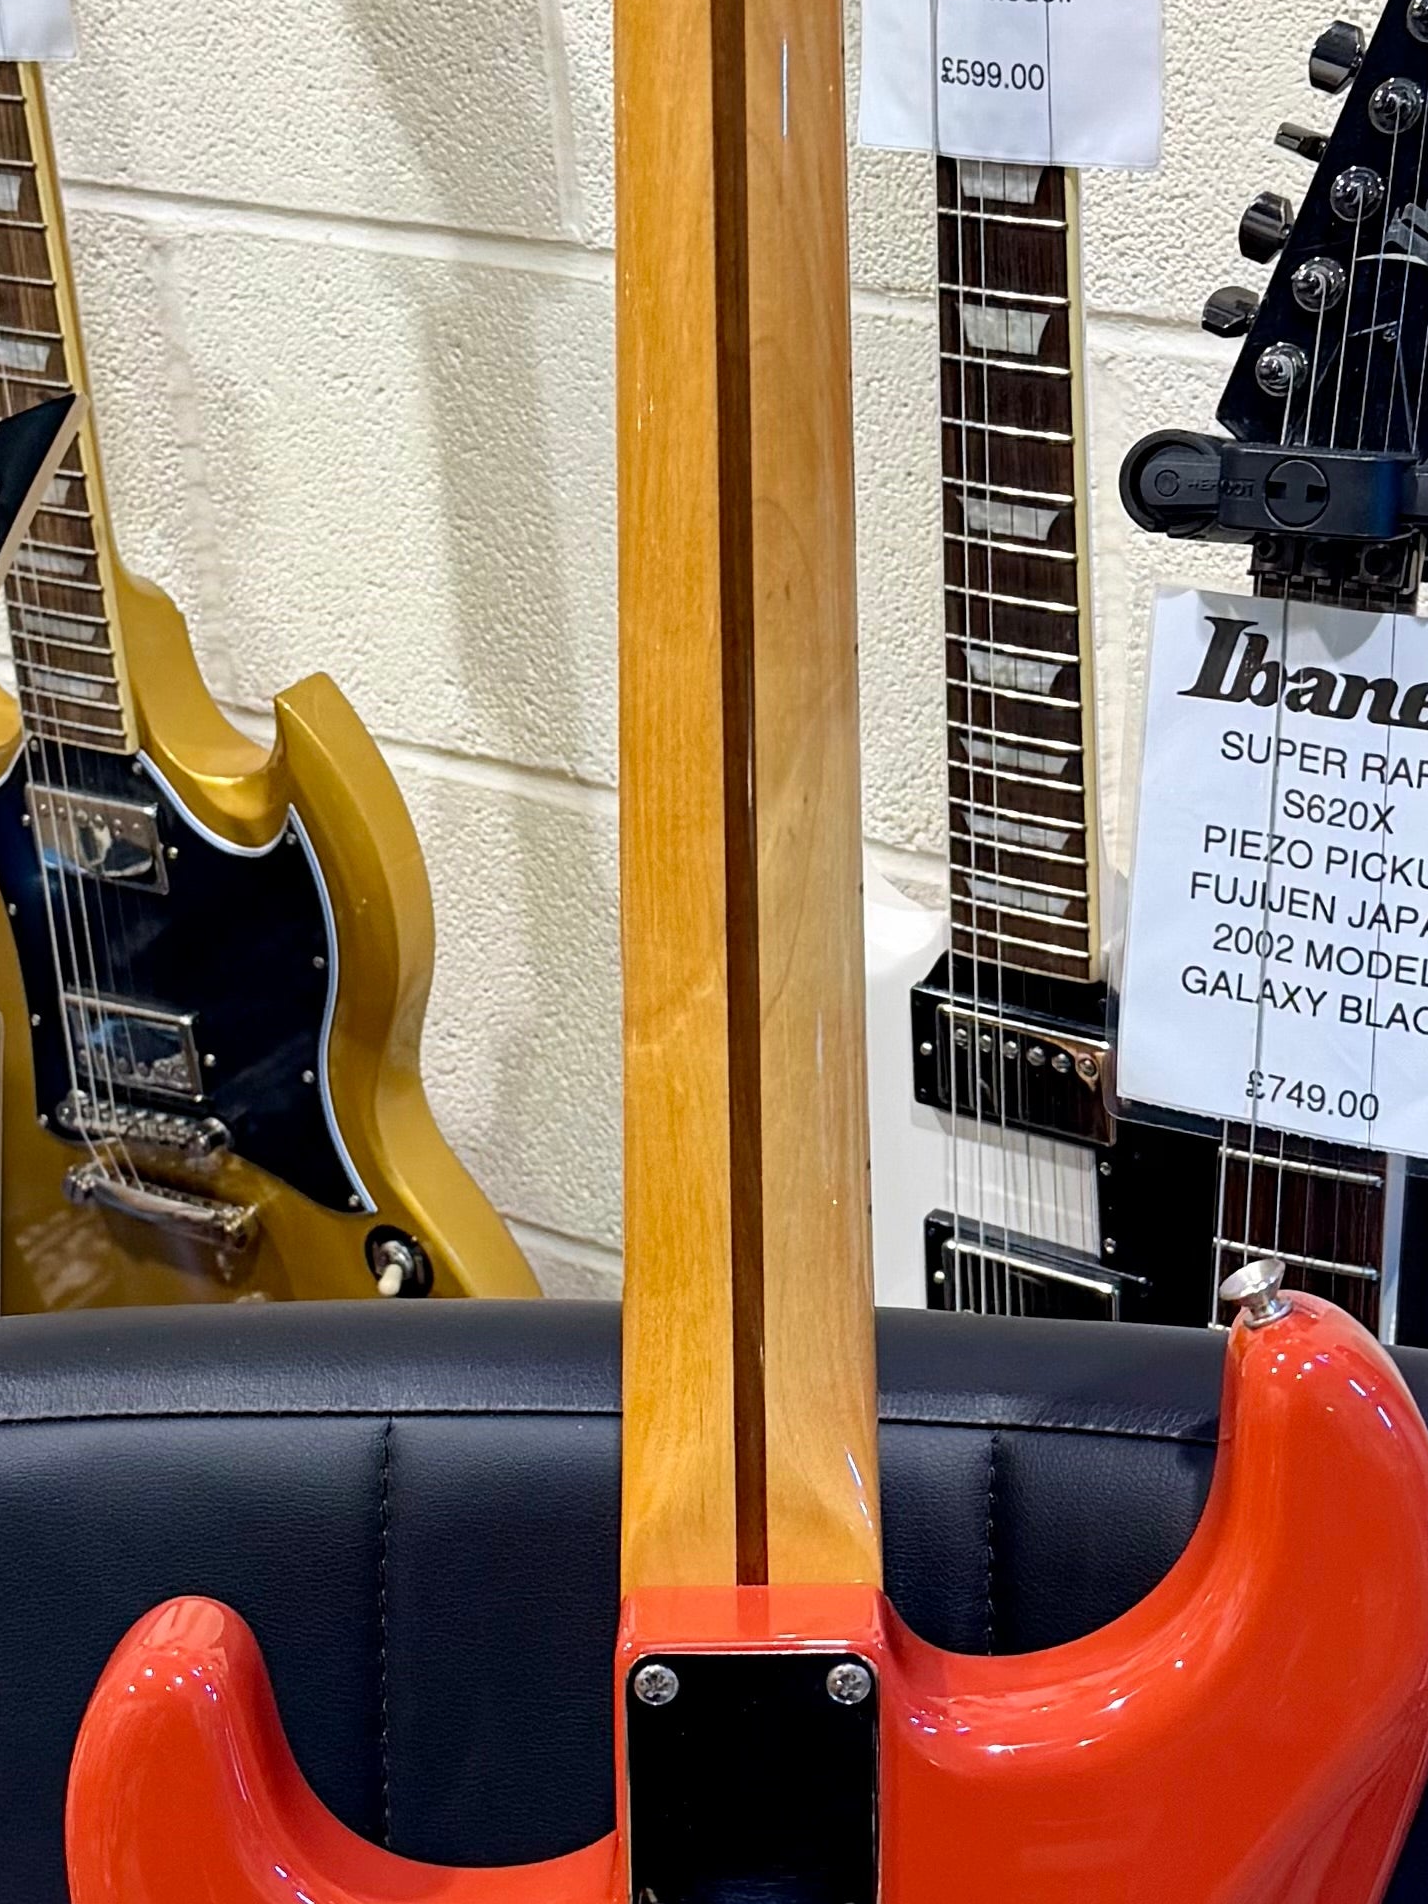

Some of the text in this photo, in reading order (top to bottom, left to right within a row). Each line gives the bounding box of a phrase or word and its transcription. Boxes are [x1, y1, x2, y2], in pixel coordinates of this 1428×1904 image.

[940, 58, 1046, 92] £599.00
[1220, 730, 1348, 781] SUPER
[1282, 788, 1396, 835] S620X
[1203, 824, 1314, 872] PIEZO
[1190, 870, 1338, 925] FUJIJEN
[1212, 923, 1294, 965] 2002
[1180, 965, 1328, 1020] GALAXY
[1245, 1068, 1381, 1124] £749.00
